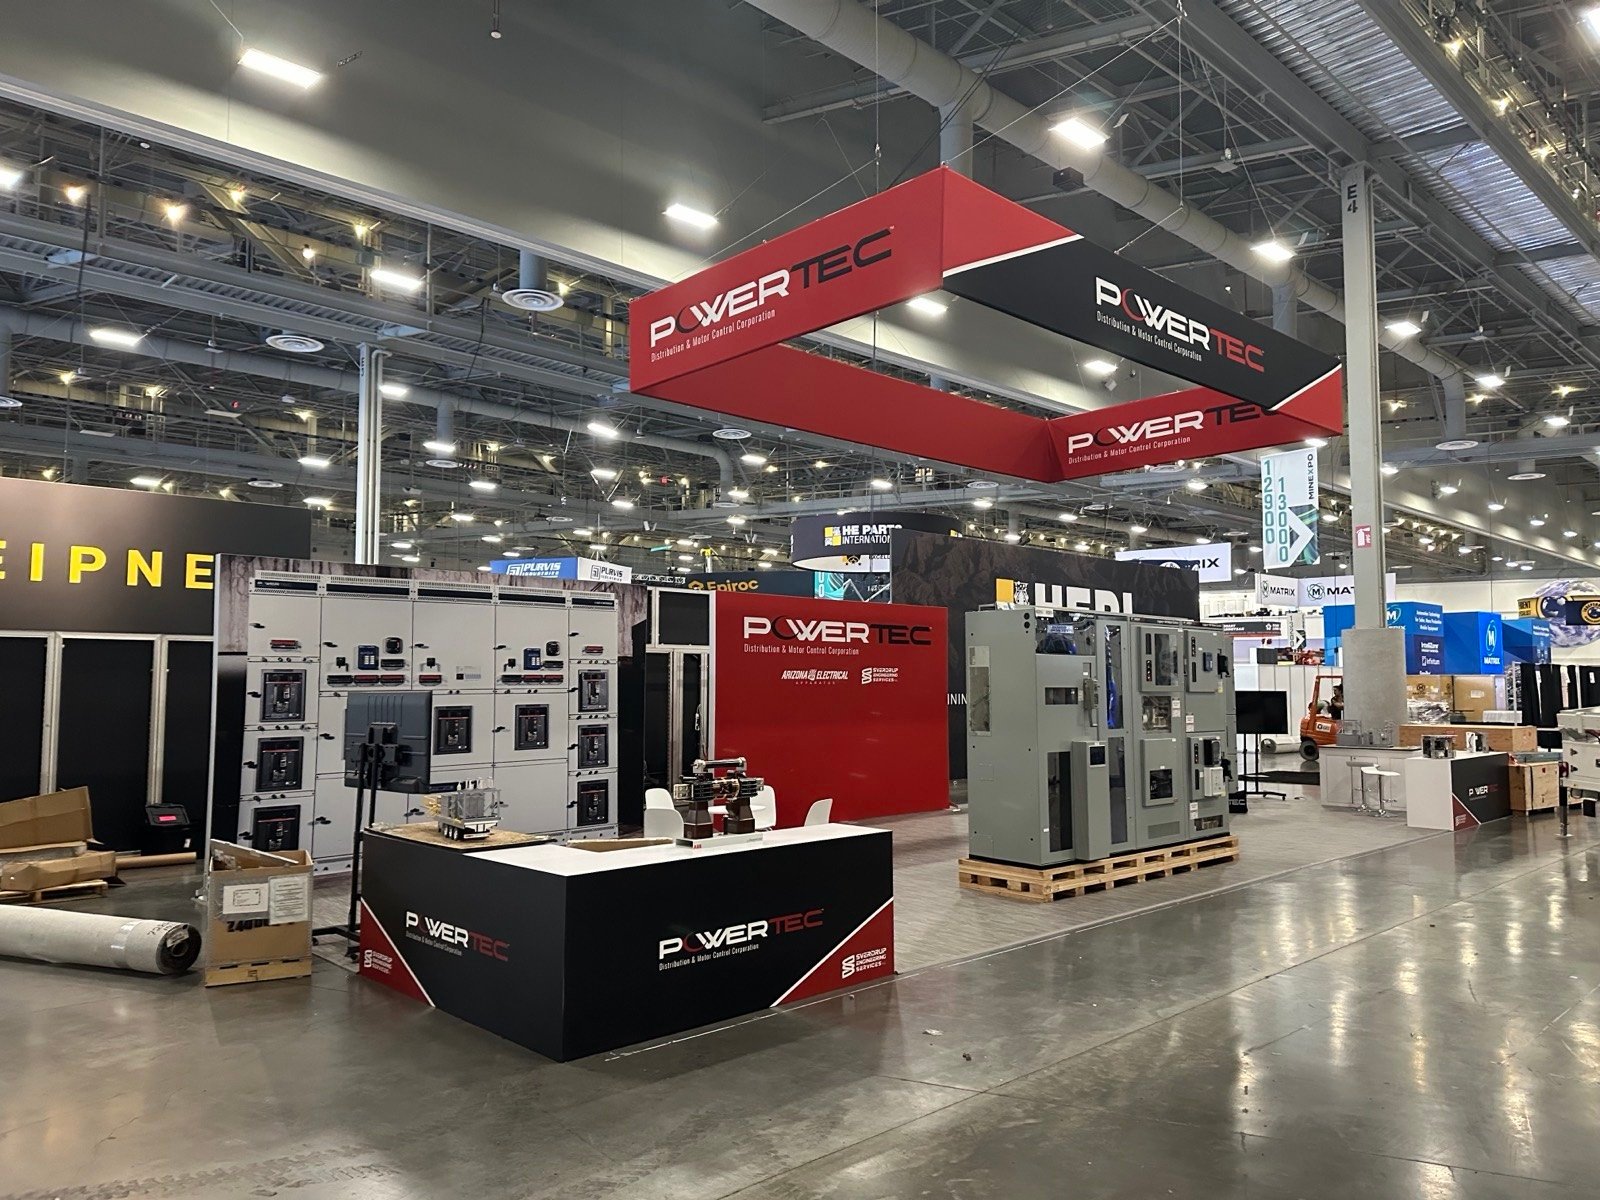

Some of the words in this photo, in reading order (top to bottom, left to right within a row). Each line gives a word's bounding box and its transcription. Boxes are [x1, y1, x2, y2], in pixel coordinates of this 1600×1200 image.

[651, 344, 684, 362] Distribution
[686, 339, 691, 349] &
[692, 333, 710, 346] Motor
[711, 322, 735, 340] Control
[736, 309, 776, 330] Corporation
[1097, 310, 1130, 333] Distribution
[1132, 325, 1136, 336] &
[1138, 328, 1153, 342] Motor
[1155, 334, 1173, 350] Control
[1174, 342, 1202, 361] Corporation
[1069, 452, 1102, 465] Distribution
[1104, 450, 1108, 458] &
[1110, 447, 1127, 457] Motor
[1129, 443, 1151, 454] Control
[1153, 436, 1191, 450] Corporation
[1264, 460, 1275, 544] 12900
[1278, 477, 1289, 562] 13000
[842, 525, 859, 535] HE
[0, 541, 214, 590] IPNE
[523, 562, 562, 572] PURVIS
[601, 566, 623, 578] PURVIS
[1270, 586, 1295, 597] MATRIX
[744, 643, 780, 653] Distribution
[782, 645, 786, 653] &
[788, 645, 804, 654] Motor
[806, 646, 826, 654] Control
[828, 646, 859, 656] Corporation
[781, 670, 809, 680] ARIZONA
[816, 670, 849, 680] ELECTRICAL
[659, 958, 690, 971] Distribution
[691, 956, 696, 964] &
[697, 953, 712, 962] Motor
[713, 949, 731, 959] Control
[732, 943, 759, 955] Corporation
[856, 947, 887, 960] SVERDRUP
[856, 954, 887, 966] ENGINEERING
[856, 961, 882, 973] SERVICES
